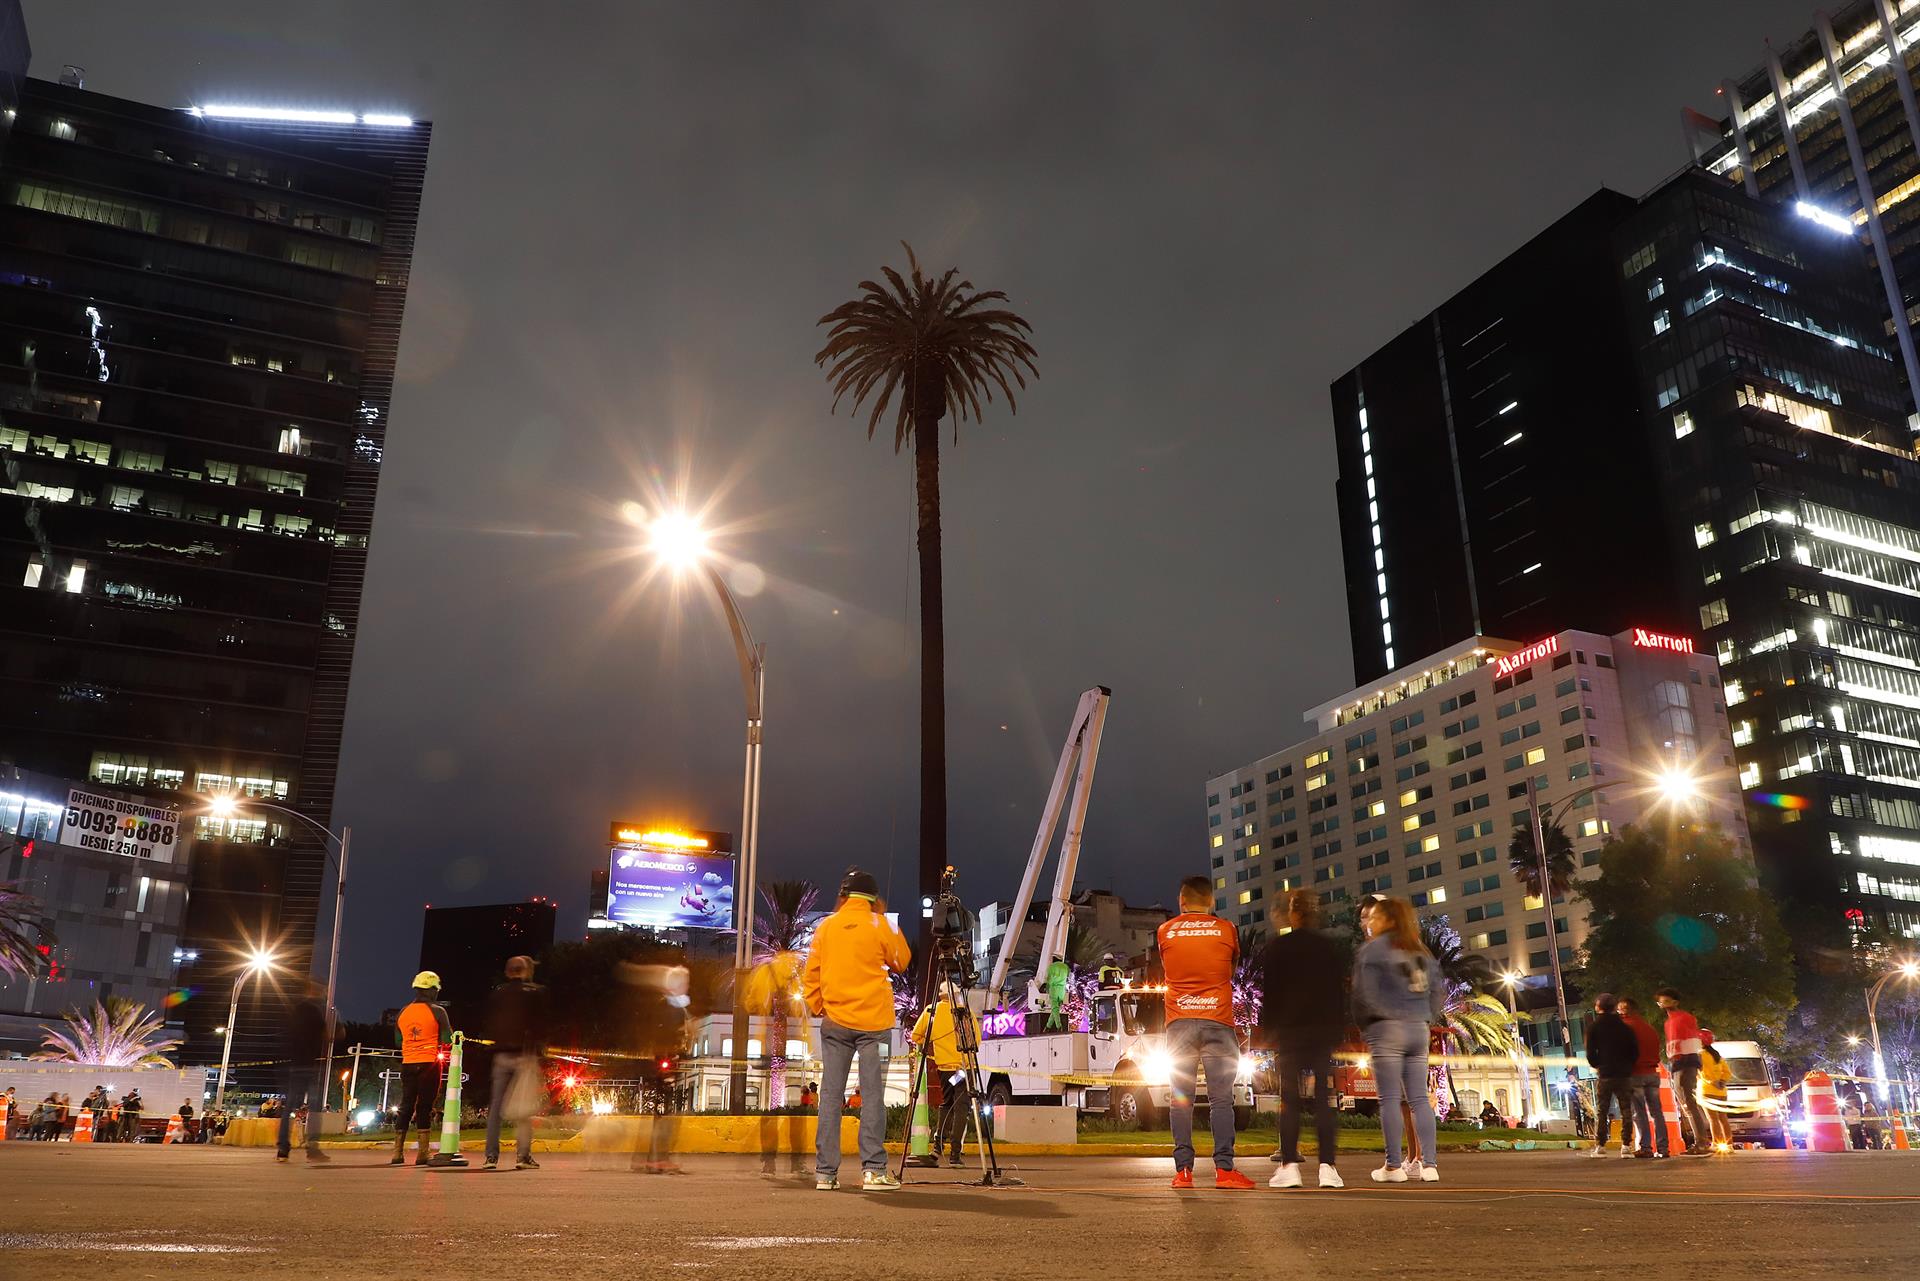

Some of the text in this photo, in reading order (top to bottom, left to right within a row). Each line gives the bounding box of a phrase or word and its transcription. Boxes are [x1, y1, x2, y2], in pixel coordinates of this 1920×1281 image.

[1634, 628, 1694, 654] Marriott
[1496, 635, 1558, 678] Marriott
[71, 791, 177, 823] OFICINAS DISPONIBLES
[66, 806, 174, 845] 5093-8888
[80, 834, 114, 851] DESDE
[116, 841, 138, 856] 250
[1177, 929, 1222, 937] SUZUKI
[1180, 920, 1217, 929] telcel
[1176, 994, 1219, 1006] Caliente
